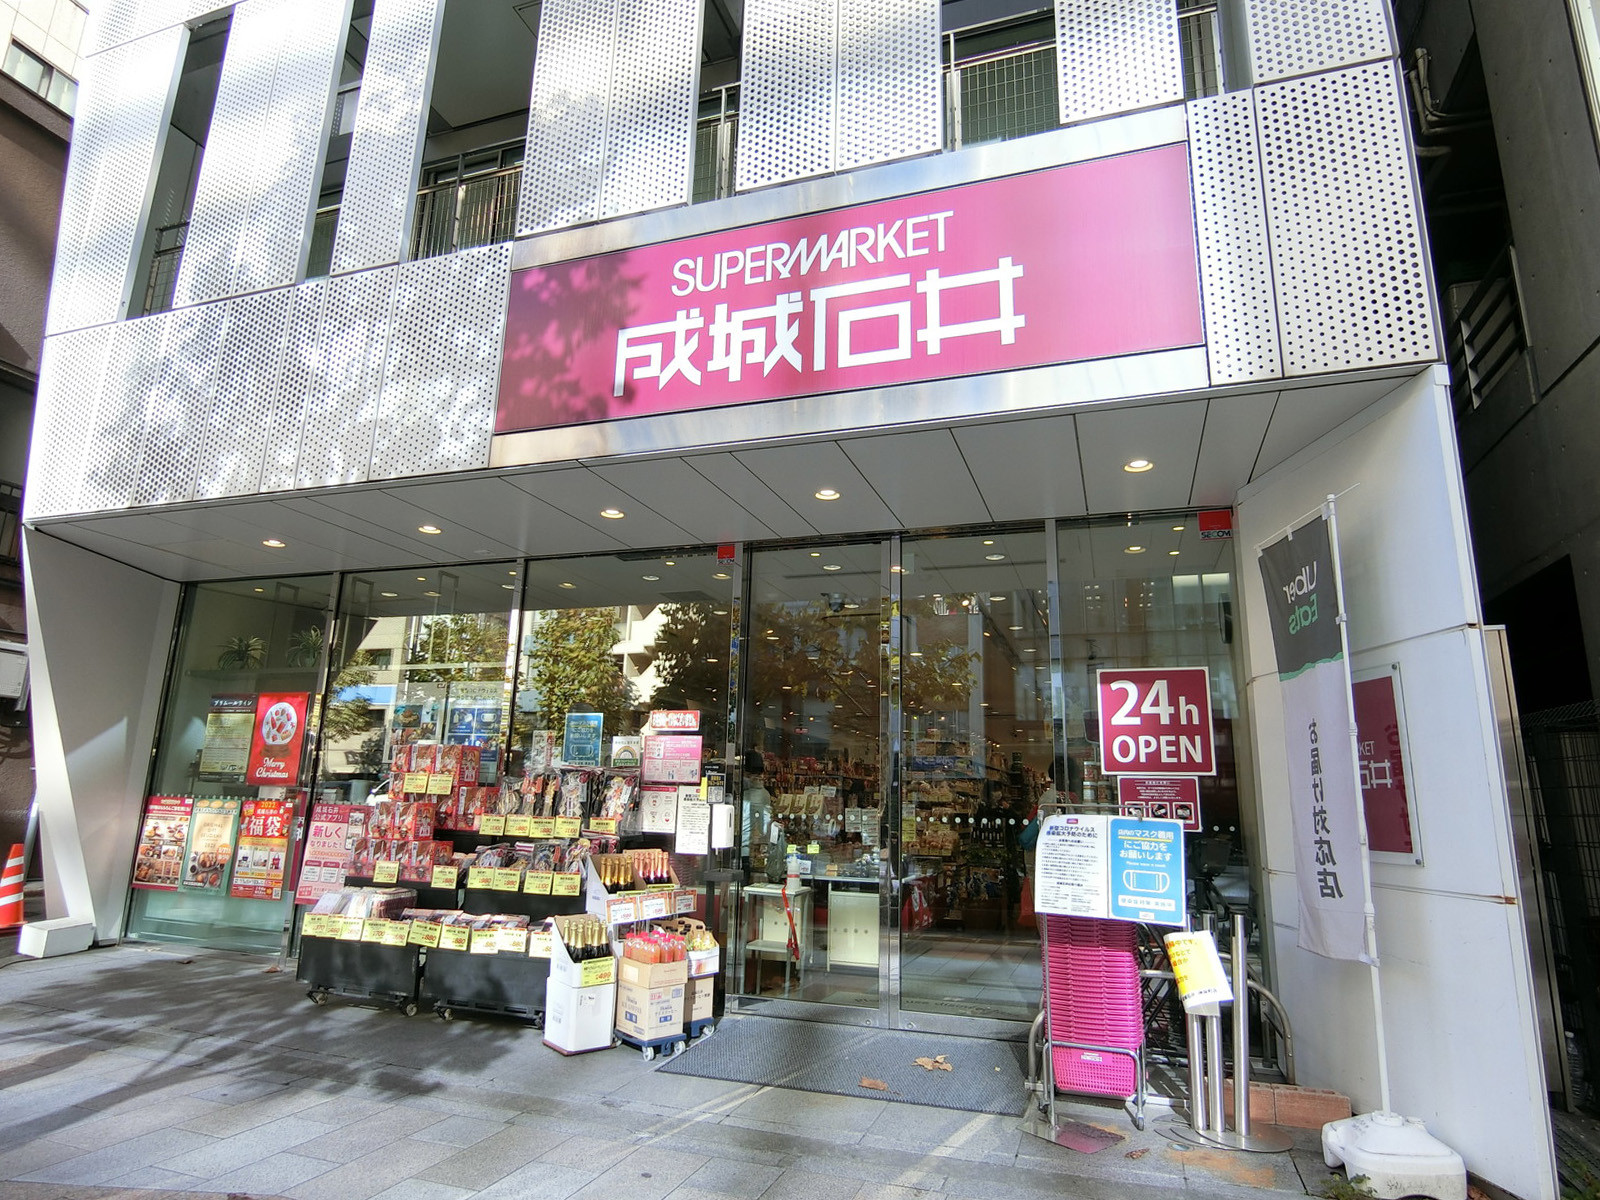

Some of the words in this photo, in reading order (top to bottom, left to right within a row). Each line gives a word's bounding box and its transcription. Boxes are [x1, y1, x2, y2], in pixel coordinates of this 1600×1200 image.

[671, 210, 954, 296] SUPERMARKET
[613, 256, 1026, 397] 成城石井
[1201, 530, 1231, 539] SECOM
[1110, 680, 1200, 726] 24h
[1112, 735, 1203, 763] OPEN
[263, 757, 285, 771] Merry
[255, 767, 289, 779] Christmas
[313, 813, 344, 822] 公式アプリ
[248, 815, 282, 837] 福袋
[312, 825, 342, 838] 新しく
[1123, 840, 1167, 852] にご協力を
[1119, 849, 1171, 862] お願いします
